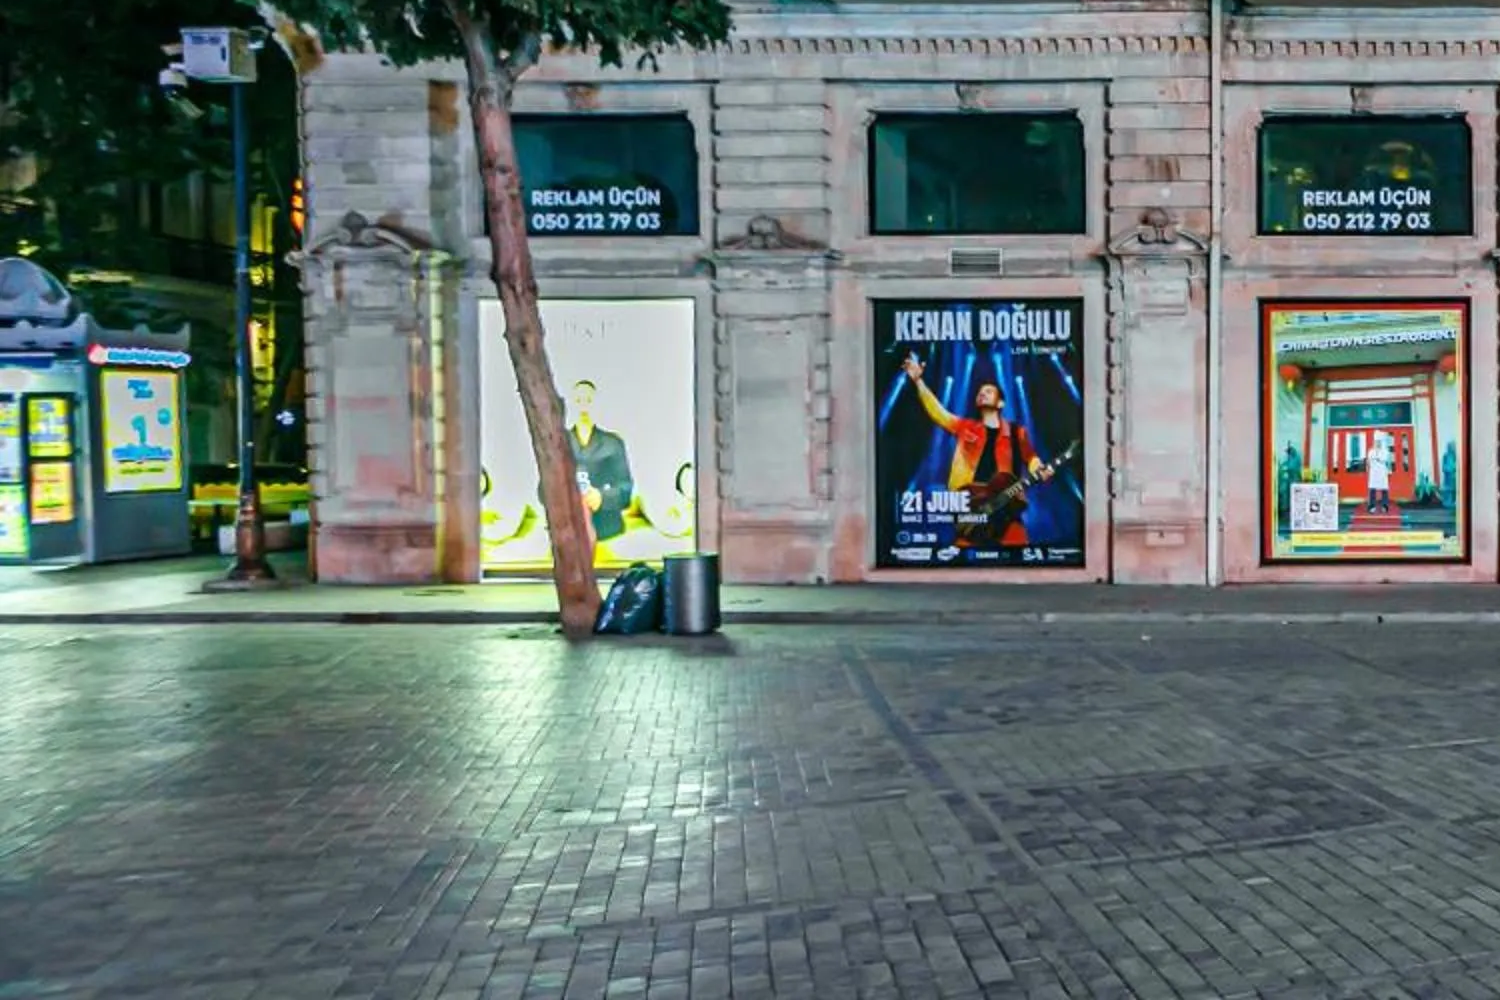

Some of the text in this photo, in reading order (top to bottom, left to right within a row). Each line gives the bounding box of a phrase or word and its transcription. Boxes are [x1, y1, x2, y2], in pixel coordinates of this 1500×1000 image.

[532, 186, 661, 209] REKLAM ÜÇÜN
[1303, 187, 1431, 209] REKLAM ÜÇÜN
[532, 213, 661, 230] 050 212 79 03
[1303, 213, 1431, 229] 050 212 79 03
[895, 303, 1071, 341] KENAN DOĞULU
[902, 490, 971, 513] 21 JUNE
